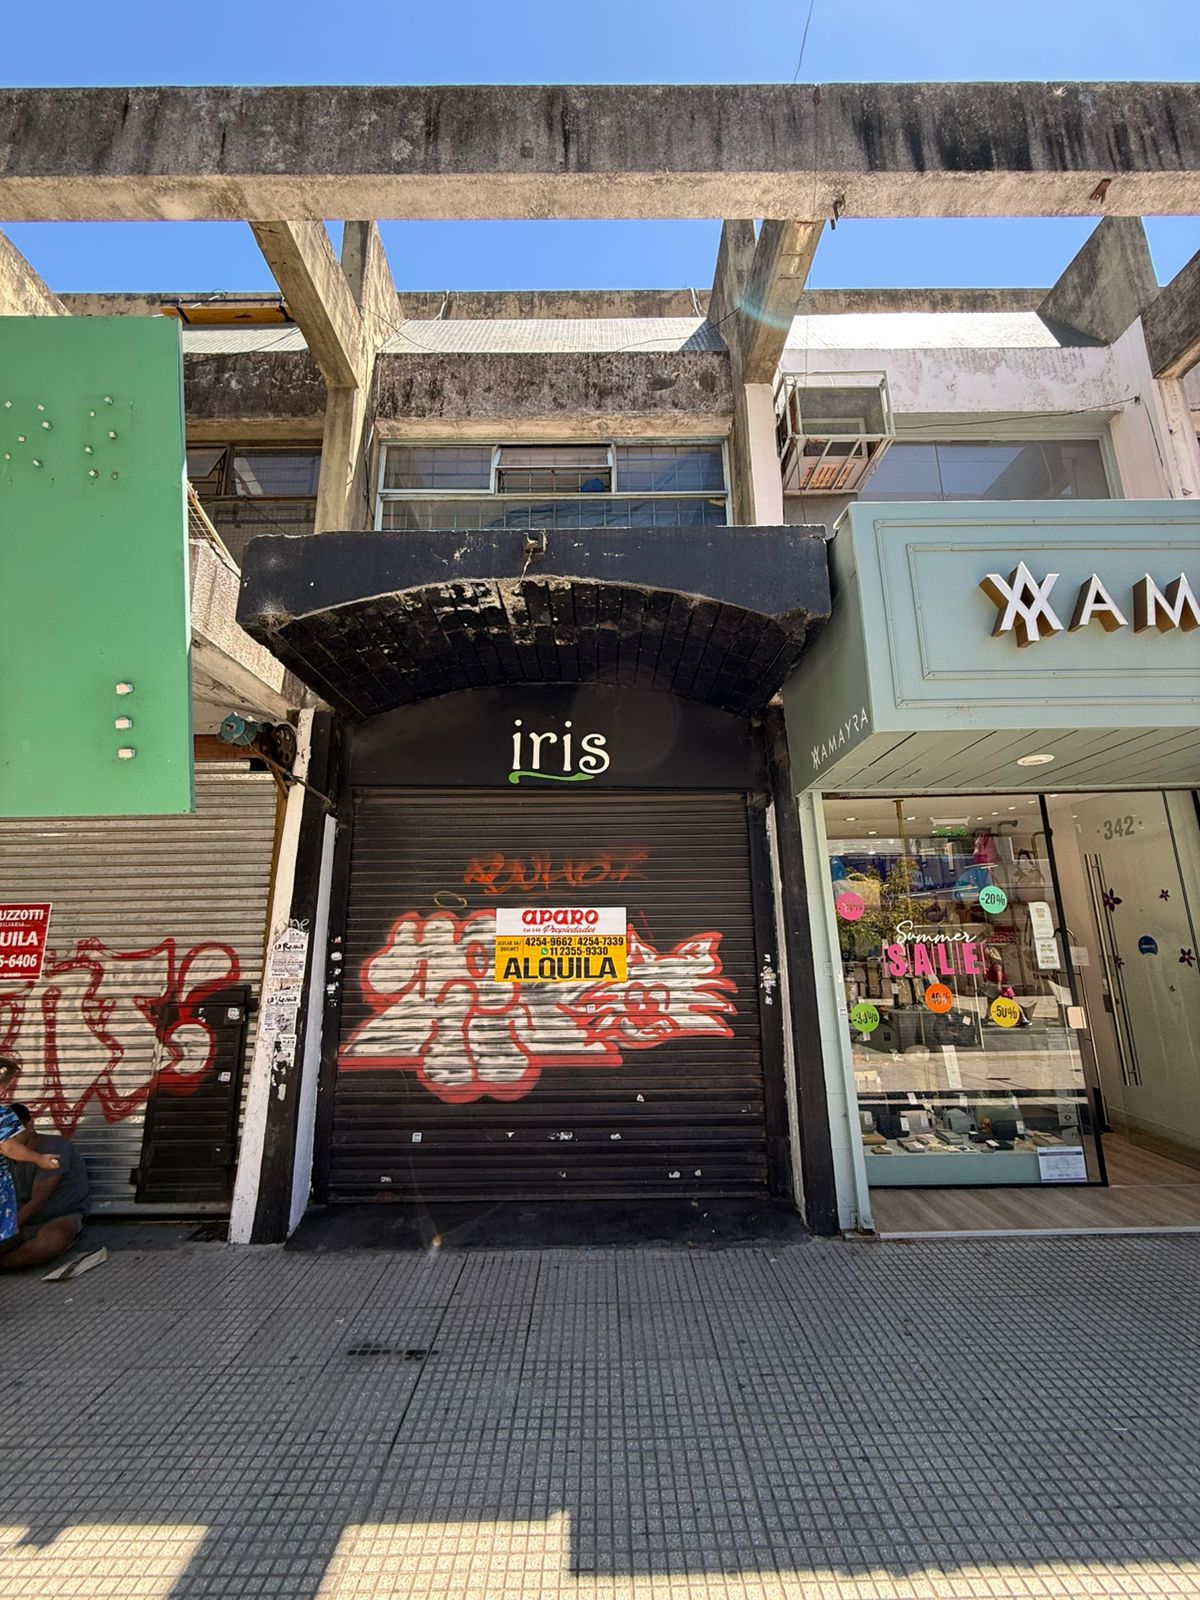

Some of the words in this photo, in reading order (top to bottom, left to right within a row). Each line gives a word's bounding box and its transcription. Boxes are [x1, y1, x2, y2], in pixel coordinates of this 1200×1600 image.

[512, 719, 610, 774] iris
[1103, 815, 1135, 840] 342
[981, 893, 1006, 906] -20%
[0, 931, 38, 947] UILA
[543, 925, 596, 934] Propiedades
[896, 920, 977, 944] Summer
[525, 937, 573, 946] 4254-9662
[577, 937, 624, 946] 4254-7339
[550, 947, 558, 956] 11
[560, 947, 609, 956] 2355-9330
[887, 943, 980, 976] SALE
[503, 957, 618, 979] ALQUILA
